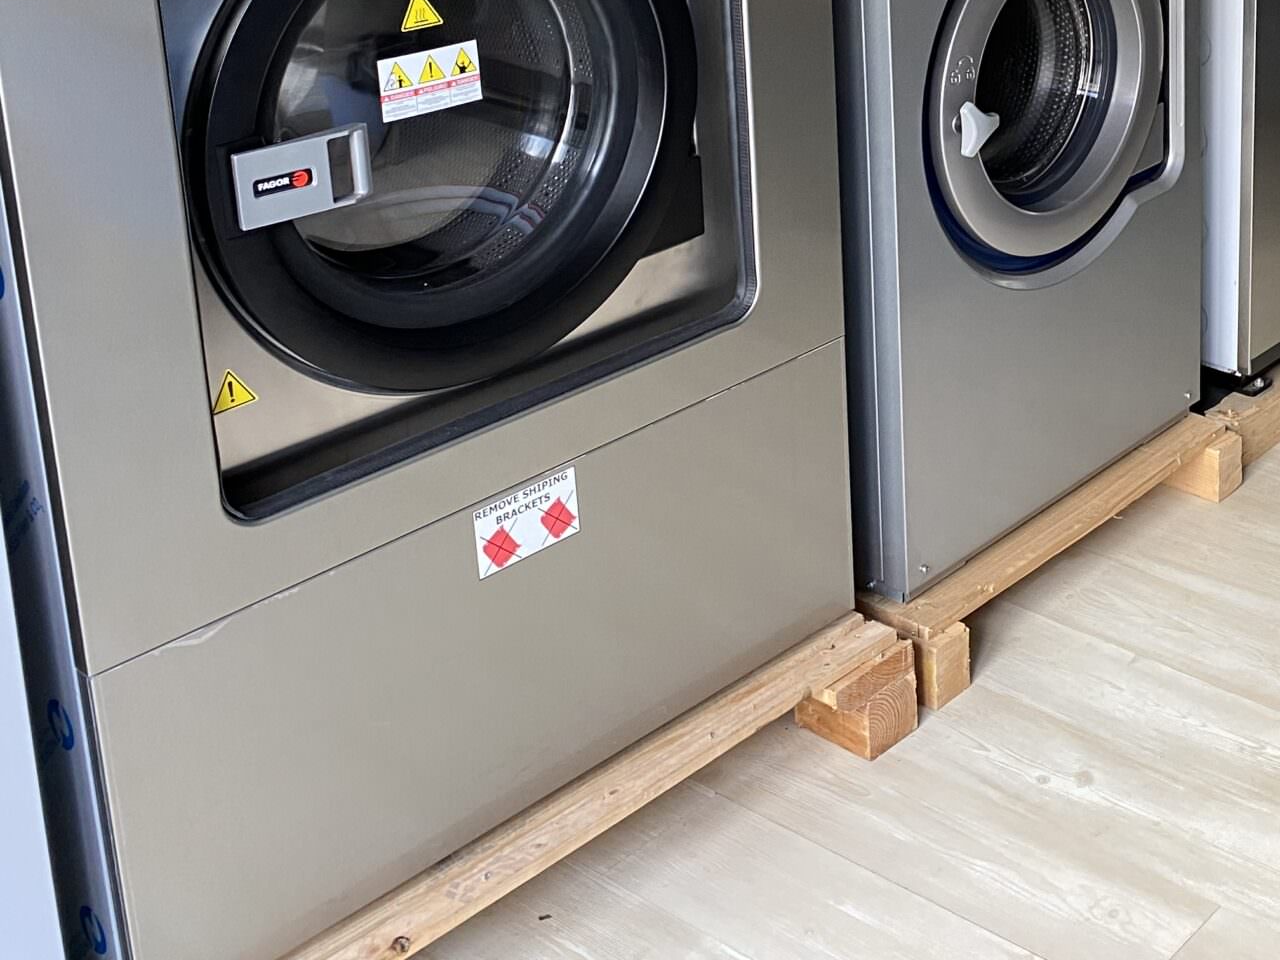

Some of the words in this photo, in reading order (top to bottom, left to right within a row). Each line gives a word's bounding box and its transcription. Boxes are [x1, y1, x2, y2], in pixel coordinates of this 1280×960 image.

[257, 177, 290, 192] FAGOR
[474, 494, 520, 521] REMOVE
[522, 471, 568, 499] SHIPING
[496, 492, 550, 525] BRACKETS
